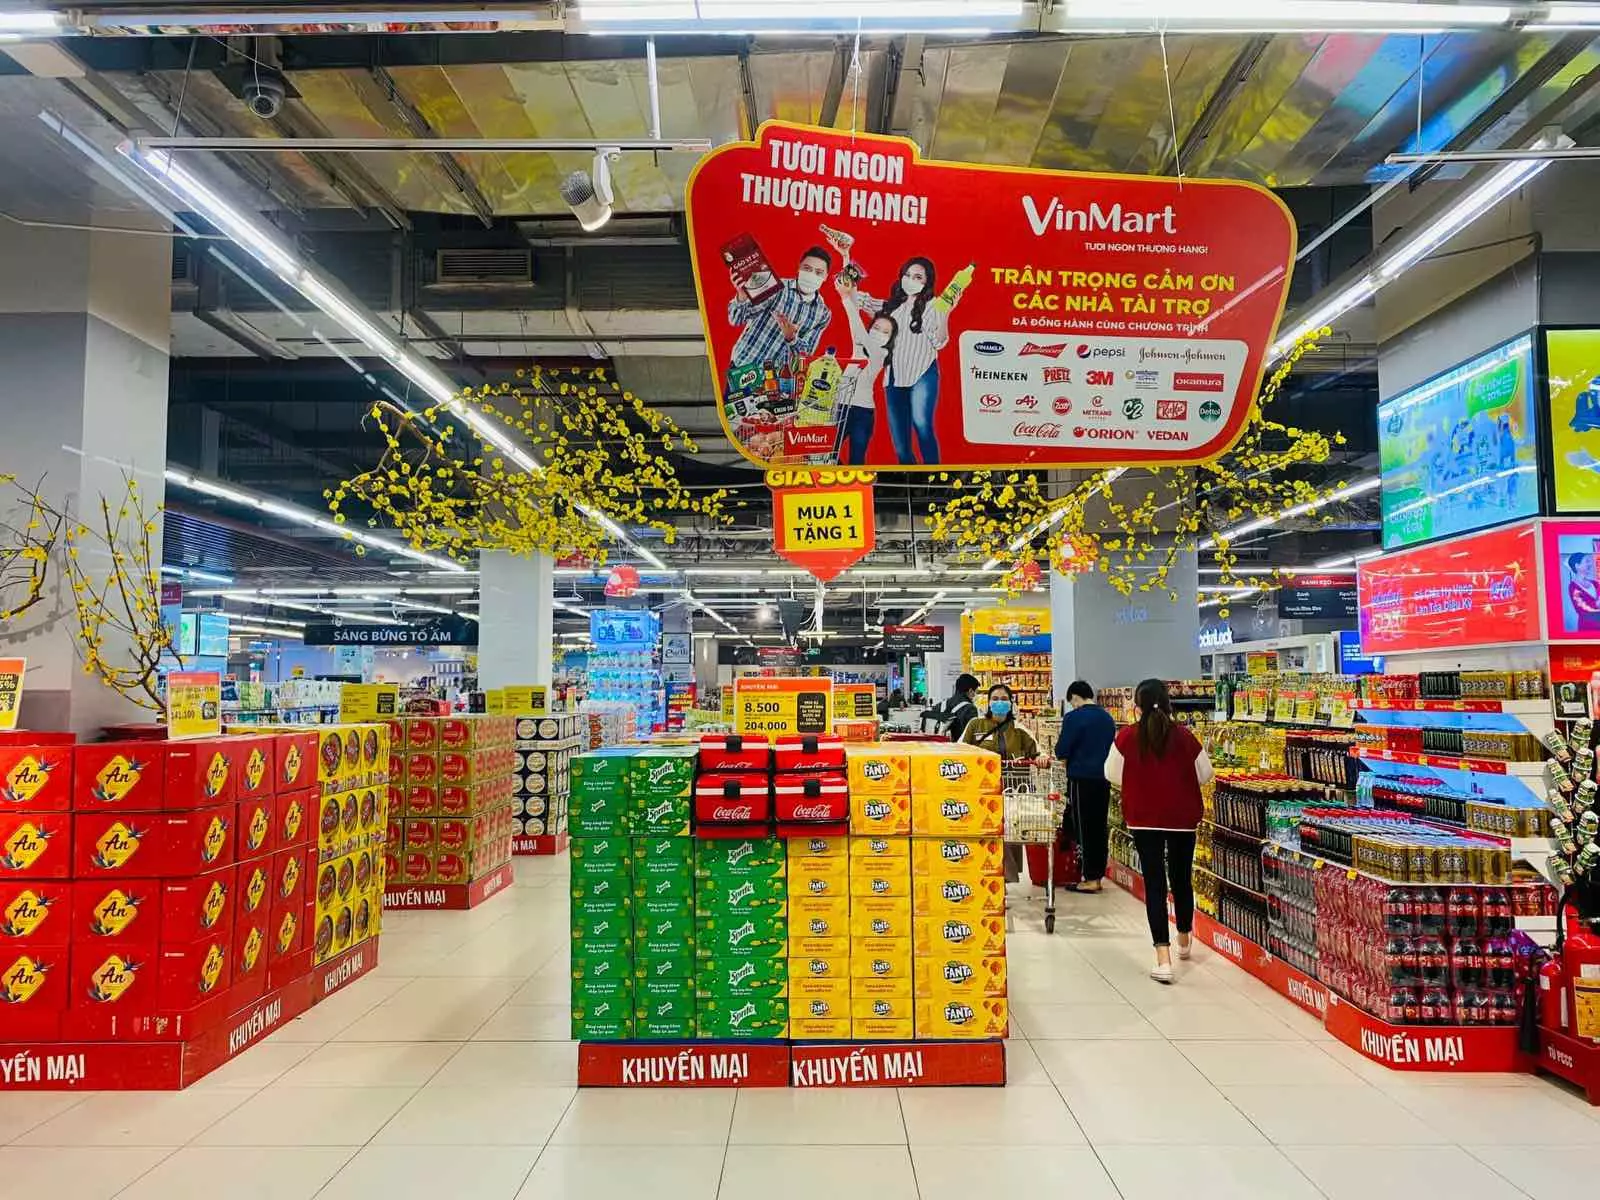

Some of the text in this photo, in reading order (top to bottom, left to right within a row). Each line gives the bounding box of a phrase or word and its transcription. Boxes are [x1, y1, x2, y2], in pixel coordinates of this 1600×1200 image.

[769, 139, 904, 184] TƯƠI NGON
[741, 173, 928, 226] THƯỢNG HẠNG!
[1022, 195, 1177, 236] VinMart
[1108, 243, 1135, 252] NGON
[990, 265, 1235, 292] TRÂN TRỌNG CẢM ƠN
[1013, 290, 1210, 318] CÁC NHÀ TÀI TRỢ
[1063, 319, 1094, 328] HÀNH
[1093, 346, 1126, 359] pepsi
[975, 370, 1028, 381] HEINEKEN
[1086, 370, 1114, 386] 3M
[1122, 401, 1144, 419] C2
[1199, 407, 1221, 415] Dettol
[788, 431, 828, 445] VinMart
[1087, 428, 1135, 440] ORION
[1147, 431, 1189, 441] VEDAN
[797, 505, 852, 520] MUA 1
[793, 522, 858, 544] TẶNG 1
[334, 628, 368, 641] SÁNG
[372, 628, 407, 642] BỪNG
[744, 702, 780, 713] 8.500
[744, 721, 787, 731] 204.000
[15, 767, 40, 784] An
[105, 766, 129, 784] An
[649, 761, 673, 782] Sprite
[863, 763, 890, 777] FANTA
[939, 763, 968, 777] FANTA
[648, 801, 672, 822] Sprite
[864, 803, 891, 817] FANTA
[941, 803, 970, 817] FANTA
[13, 834, 38, 851] An
[105, 834, 129, 851] An
[942, 843, 970, 857] FANTA
[729, 843, 753, 863] Sprite
[424, 889, 446, 908] MẠI
[729, 884, 754, 902] Sprite
[943, 884, 971, 898] FANTA
[13, 902, 38, 919] An
[102, 901, 127, 919] An
[730, 923, 754, 943] Sprite
[943, 924, 971, 939] FANTA
[10, 967, 35, 985] An
[100, 966, 126, 984] An
[324, 958, 352, 993] KHUYẾN
[730, 963, 754, 984] Sprite
[943, 964, 973, 979] FANTA
[731, 1004, 755, 1024] Sprite
[944, 1005, 974, 1020] FANTA
[229, 998, 281, 1054] KHUYẾN MẠI
[1360, 1027, 1464, 1066] KHUYẾN MẠI
[0, 1050, 85, 1084] YẾN MẠI
[622, 1048, 748, 1084] KHUYẾN MẠI
[791, 1047, 924, 1087] KHUYẾN MẠI
